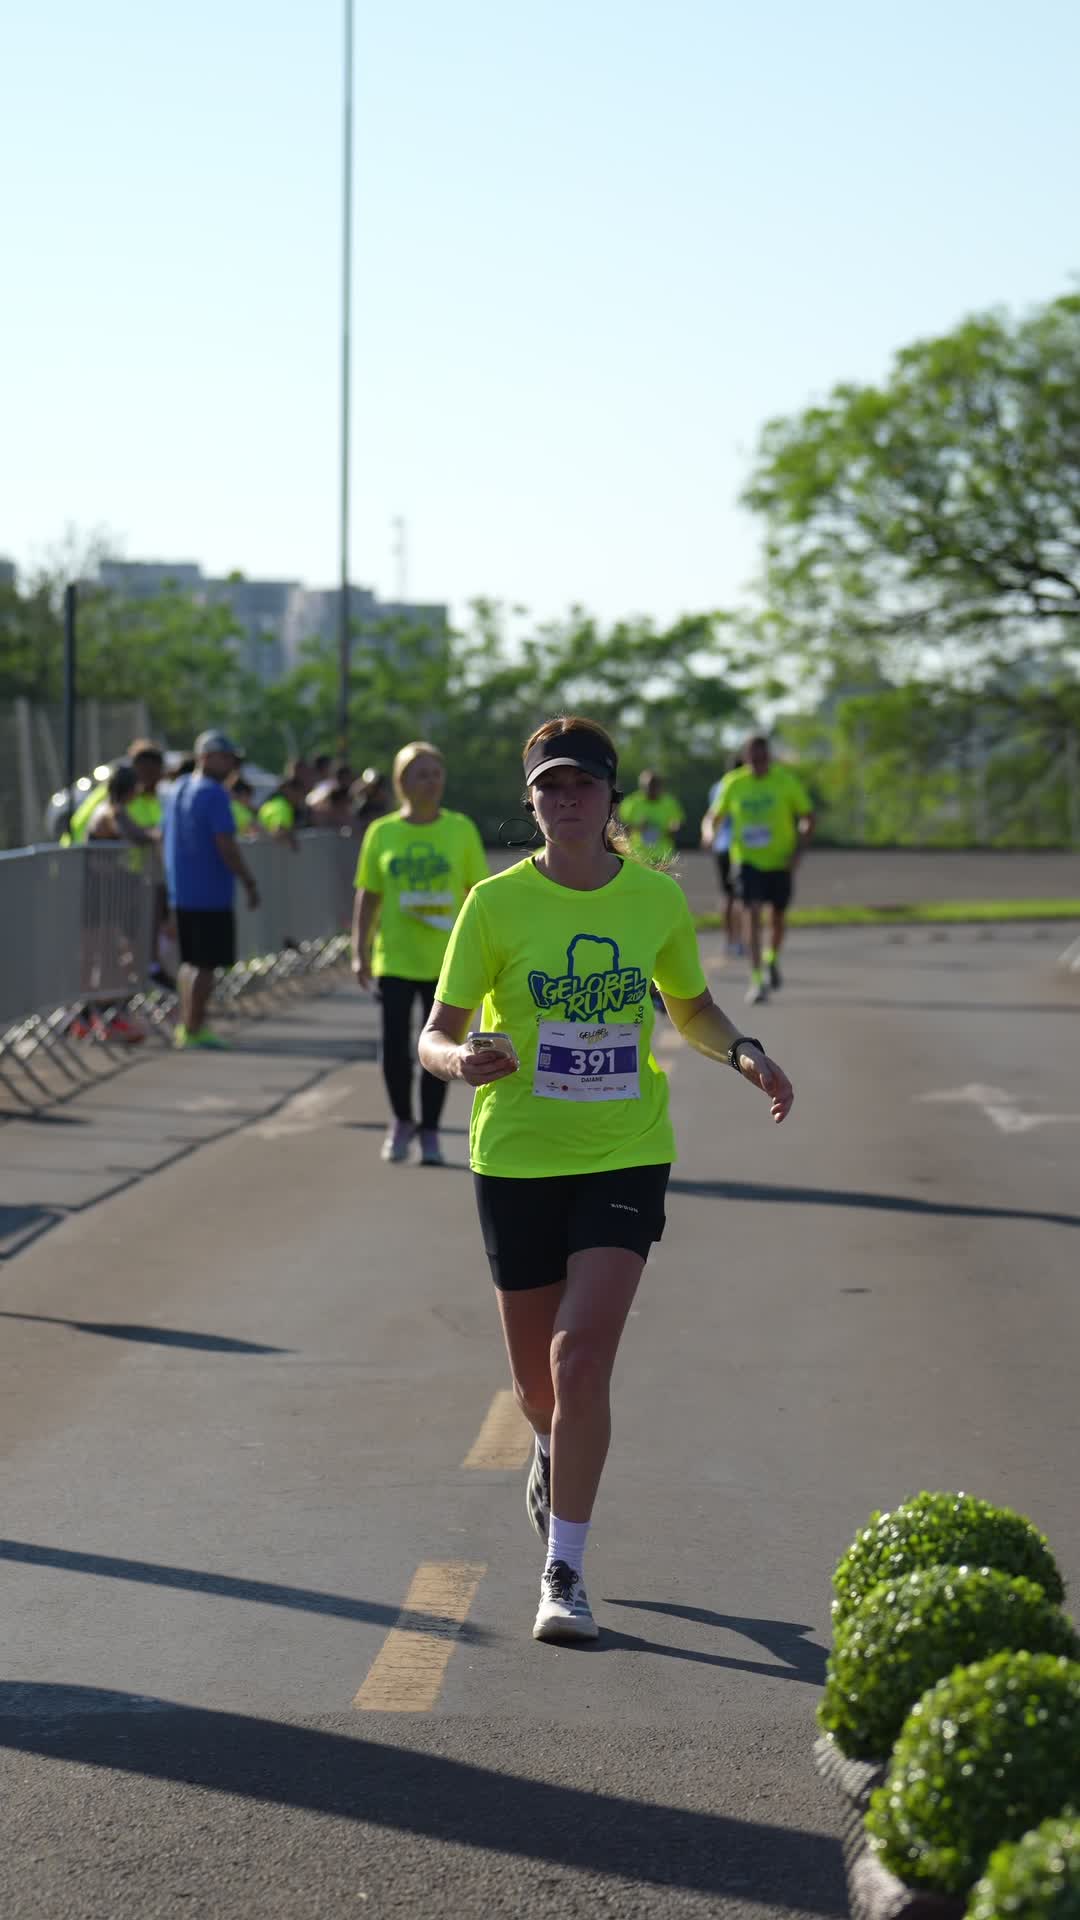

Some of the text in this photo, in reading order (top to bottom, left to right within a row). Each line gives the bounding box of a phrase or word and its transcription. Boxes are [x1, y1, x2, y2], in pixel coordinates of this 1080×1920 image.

[542, 970, 646, 1003] GELOBEL
[568, 989, 624, 1020] RUN
[569, 1048, 615, 1075] 391
